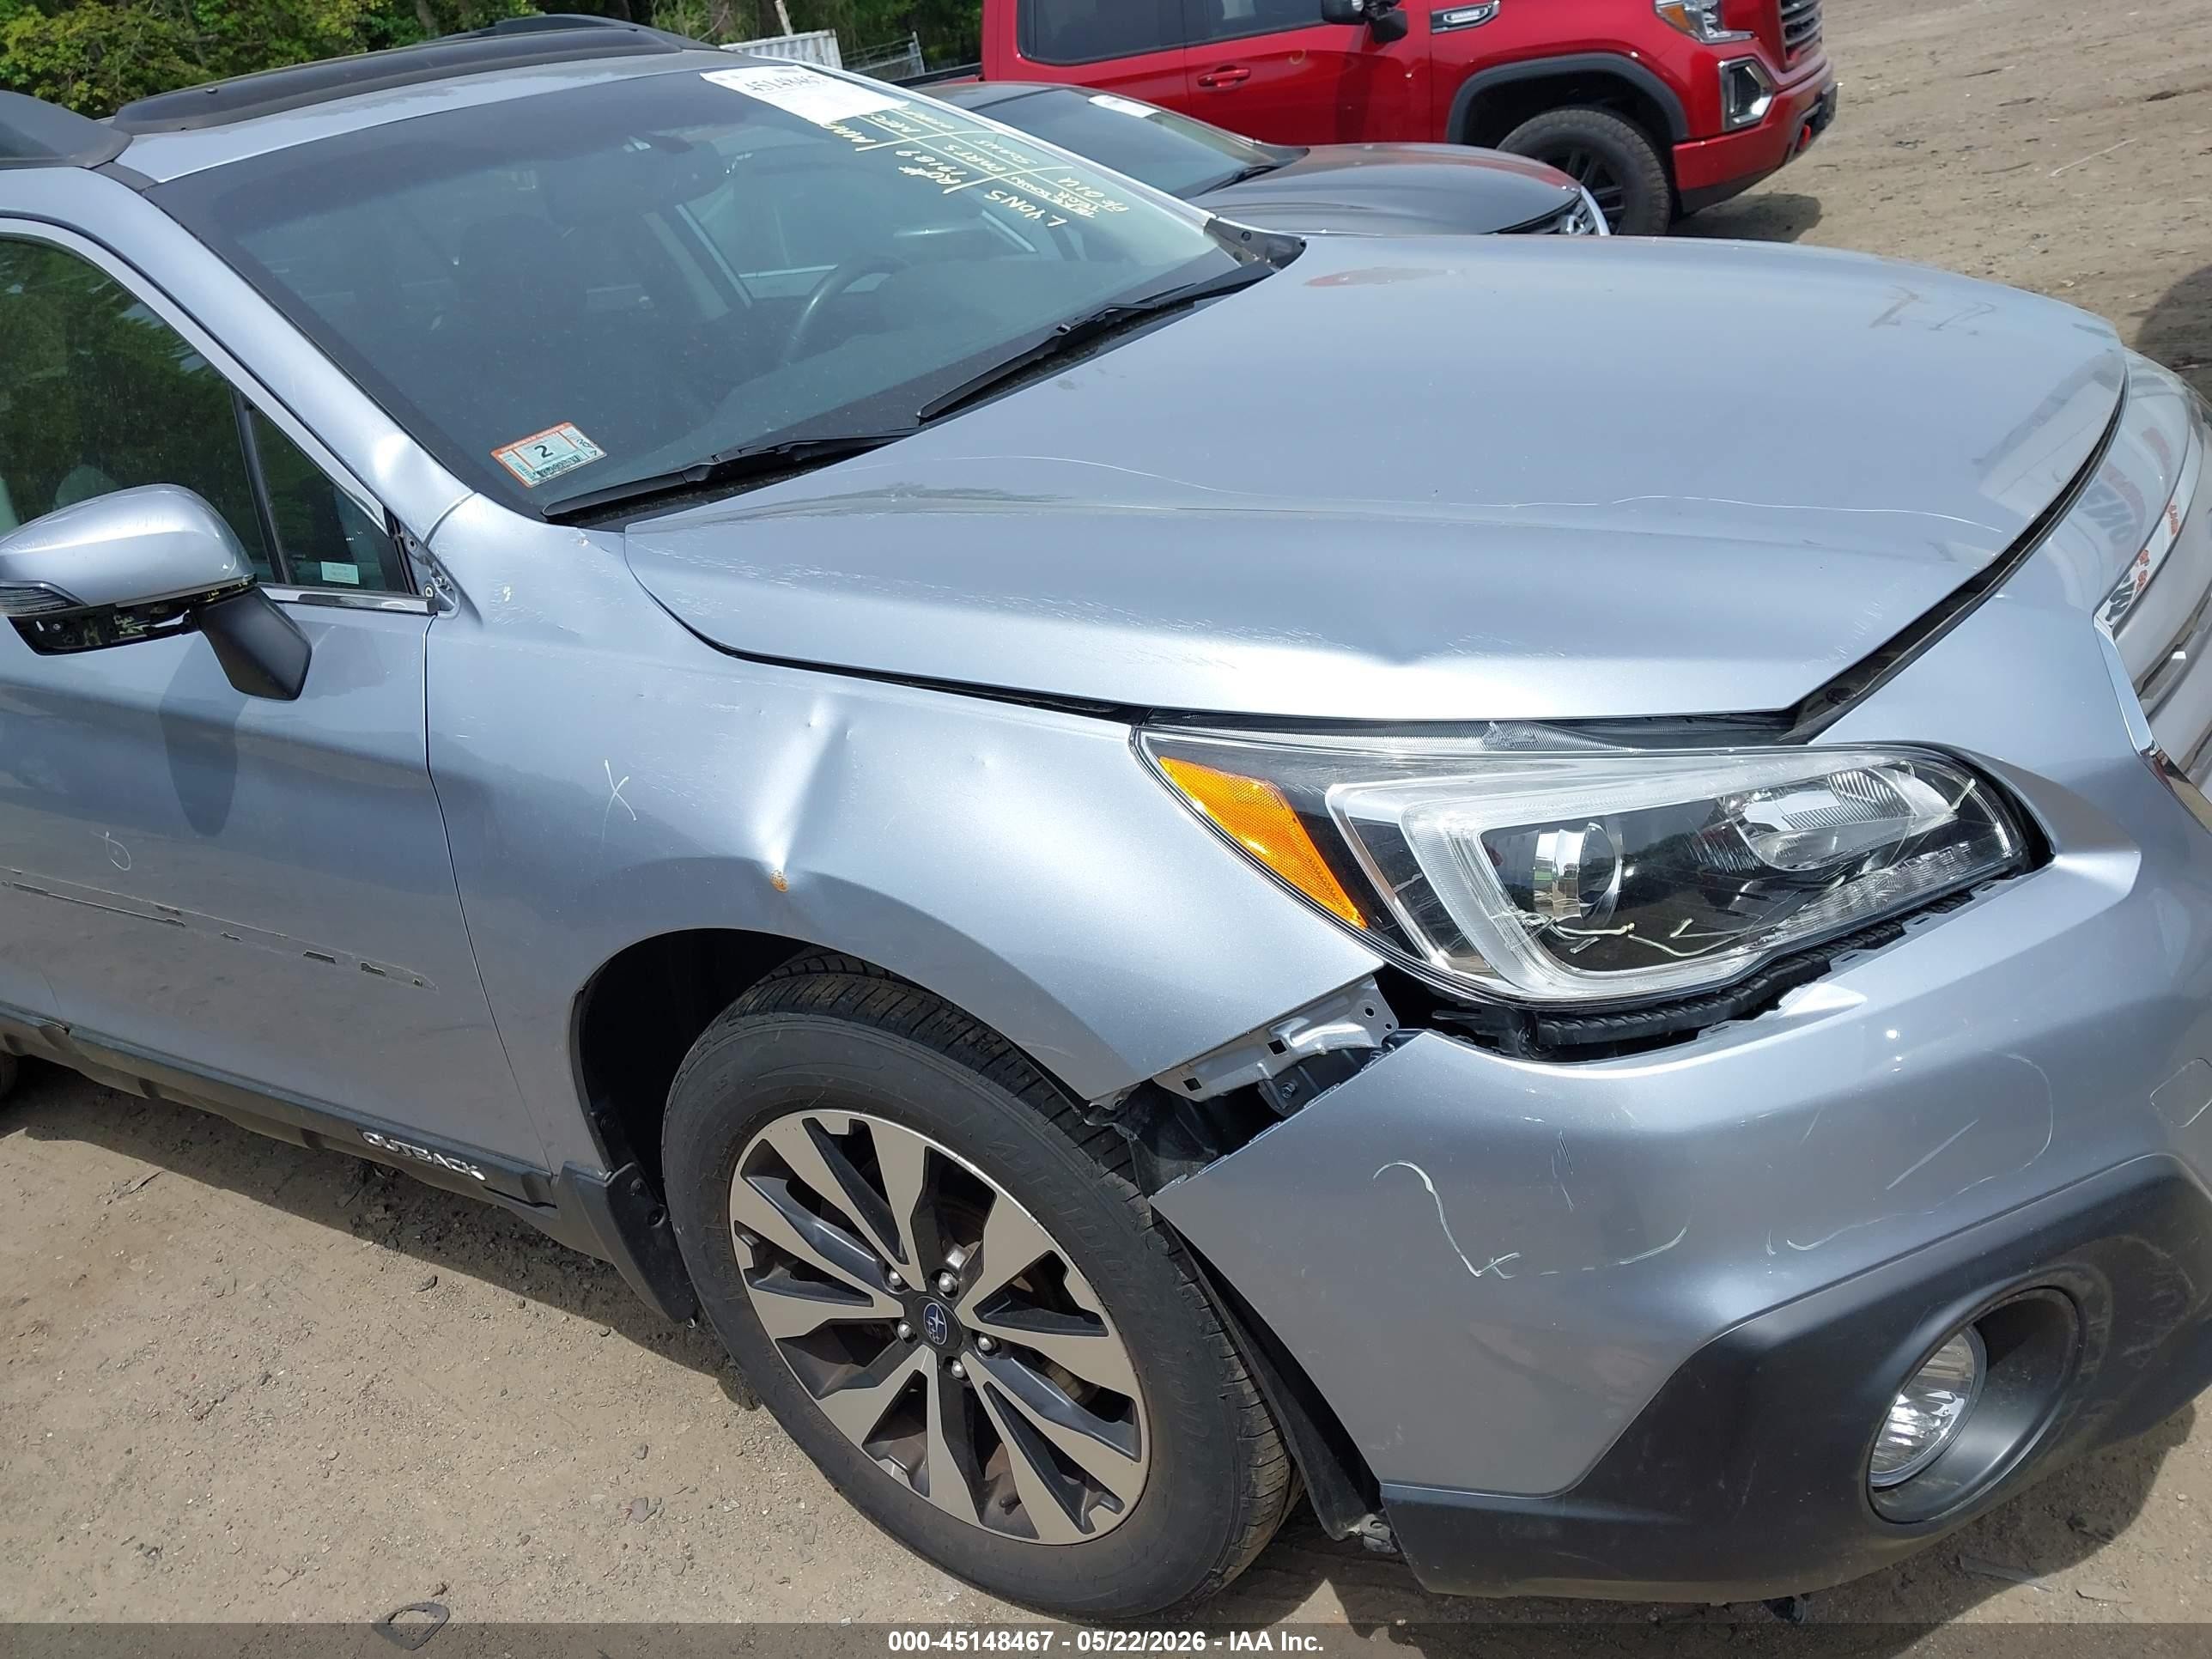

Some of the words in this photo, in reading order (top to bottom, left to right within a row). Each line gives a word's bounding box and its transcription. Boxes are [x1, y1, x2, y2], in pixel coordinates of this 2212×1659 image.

[945, 144, 1007, 173] PARTS
[984, 190, 1067, 227] LYONS
[533, 445, 555, 459] 2
[362, 1131, 487, 1181] OUTBACK
